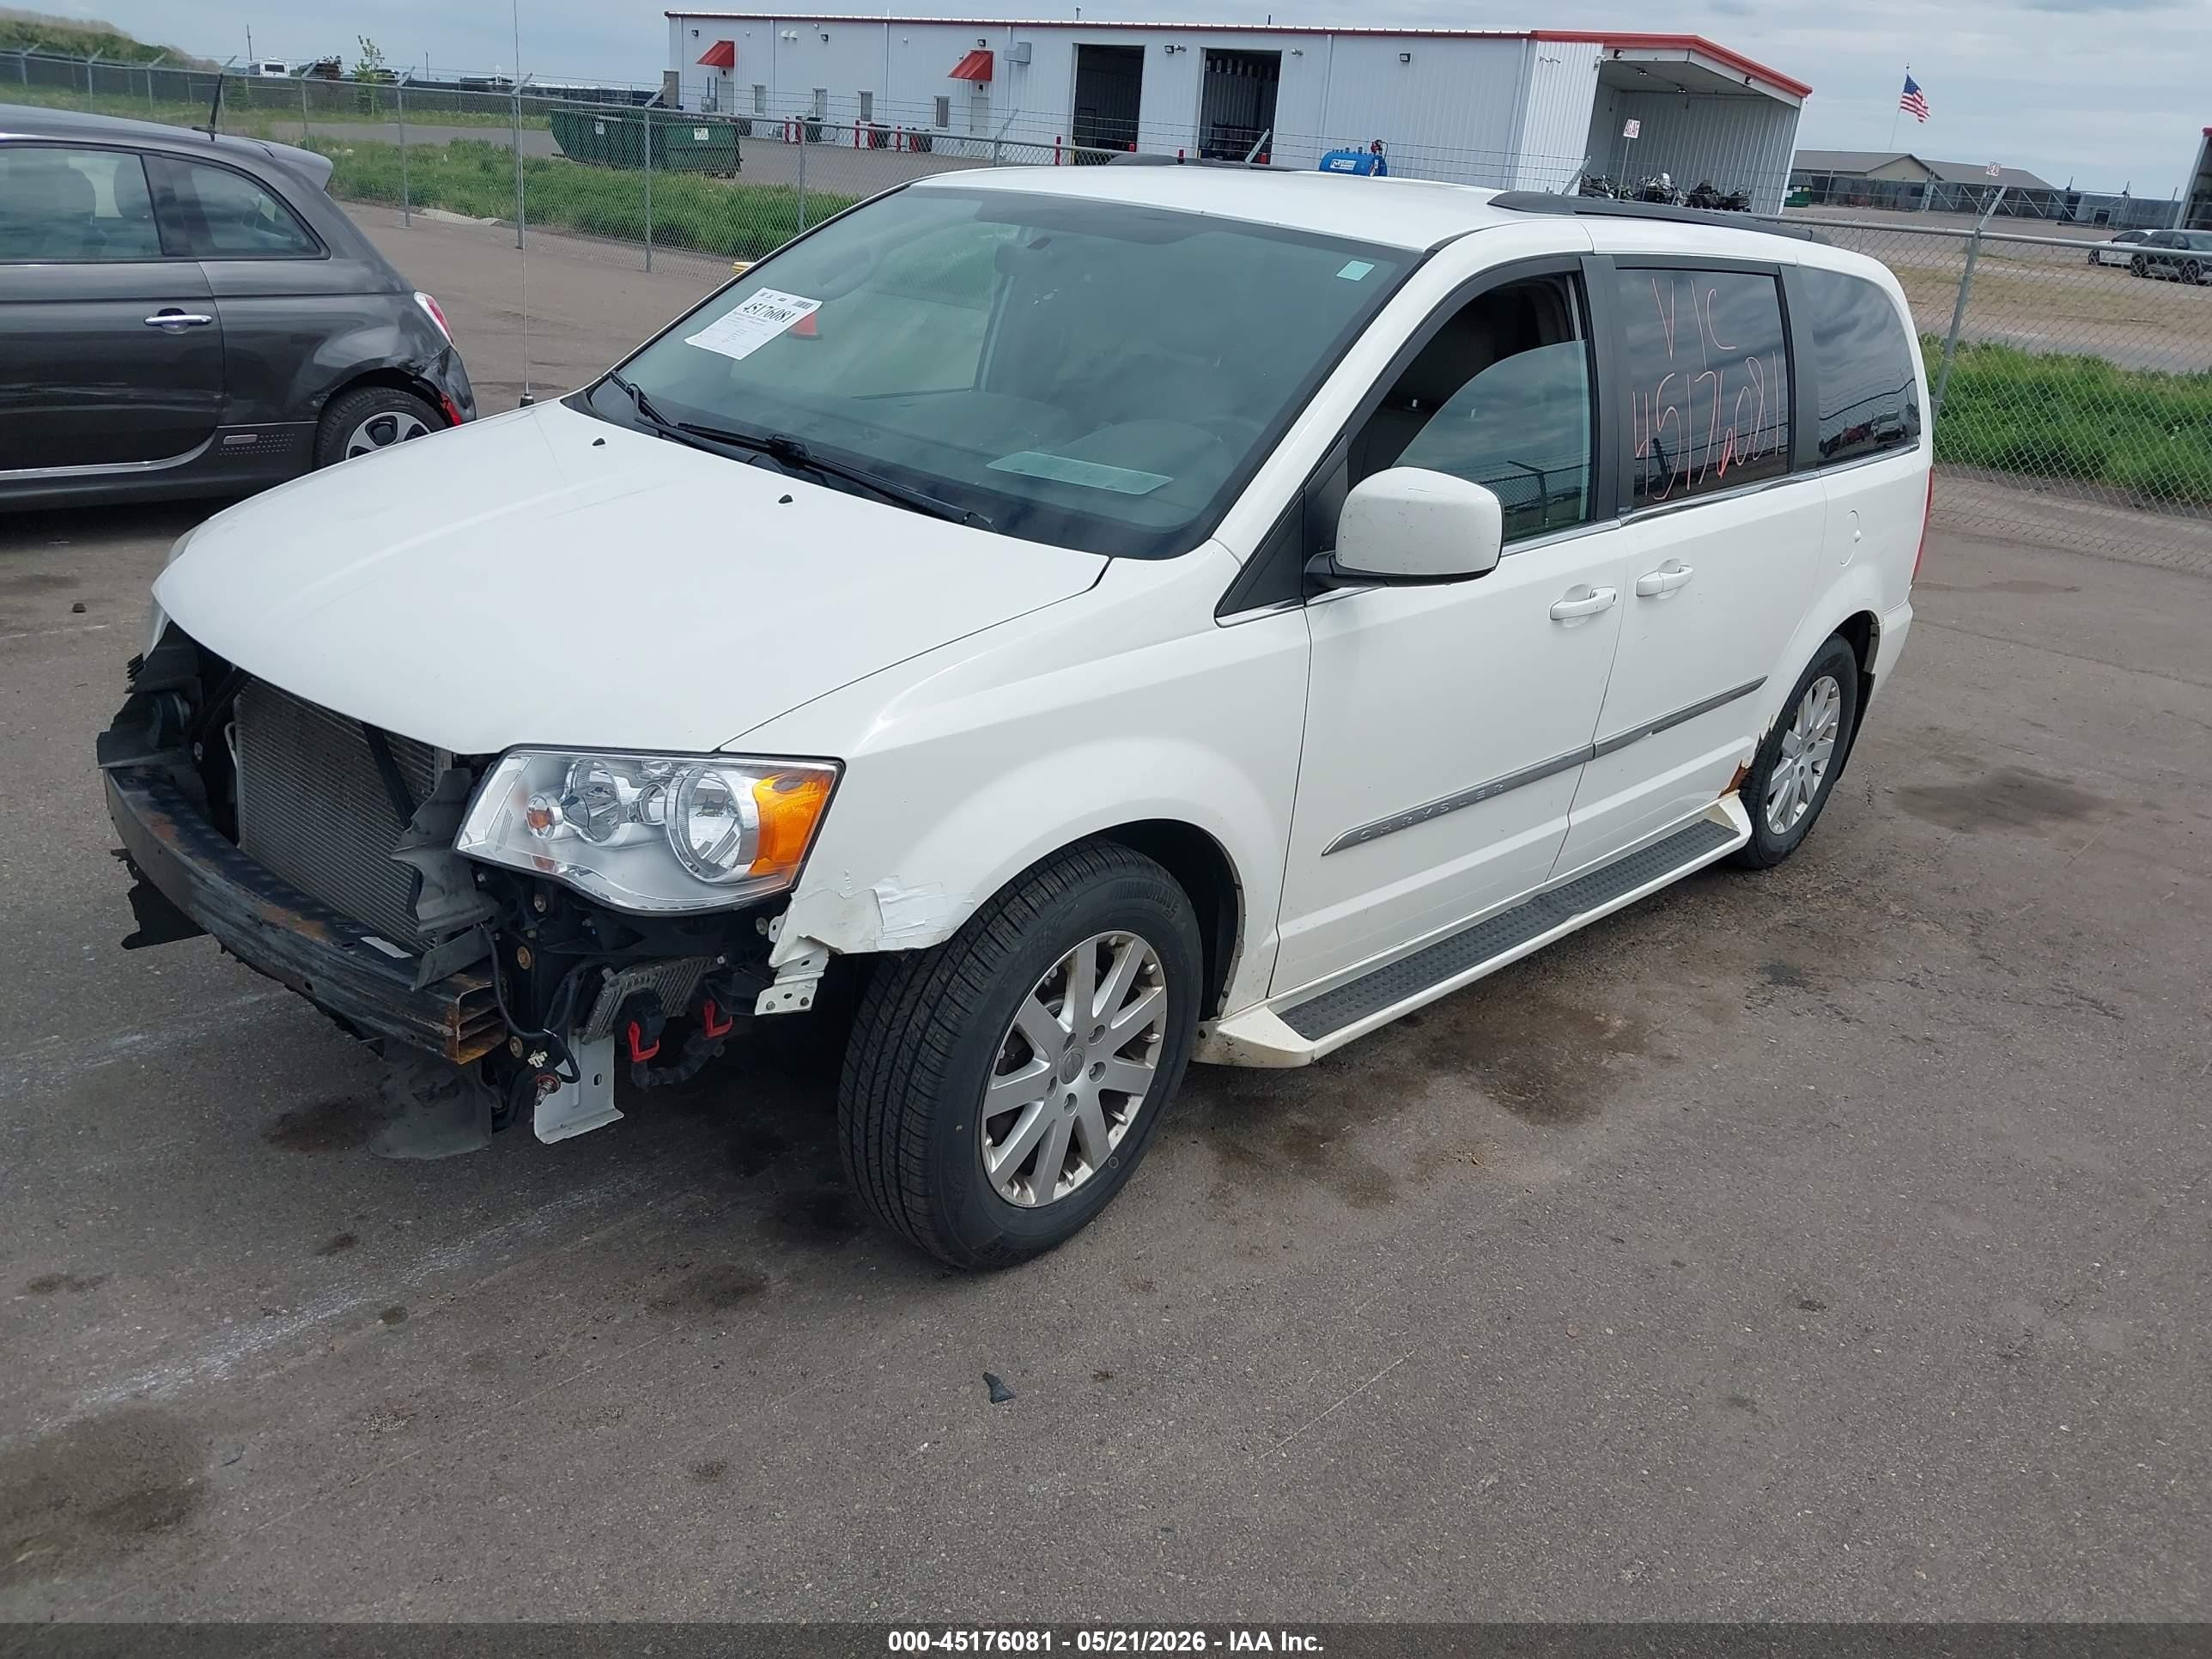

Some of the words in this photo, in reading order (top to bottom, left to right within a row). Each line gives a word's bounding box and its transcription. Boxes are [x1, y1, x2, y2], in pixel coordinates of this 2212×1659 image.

[742, 301, 798, 324] 45176081
[1652, 277, 1737, 372] VIC
[1632, 349, 1778, 501] 45176081
[1359, 783, 1504, 841] CHRYSLER
